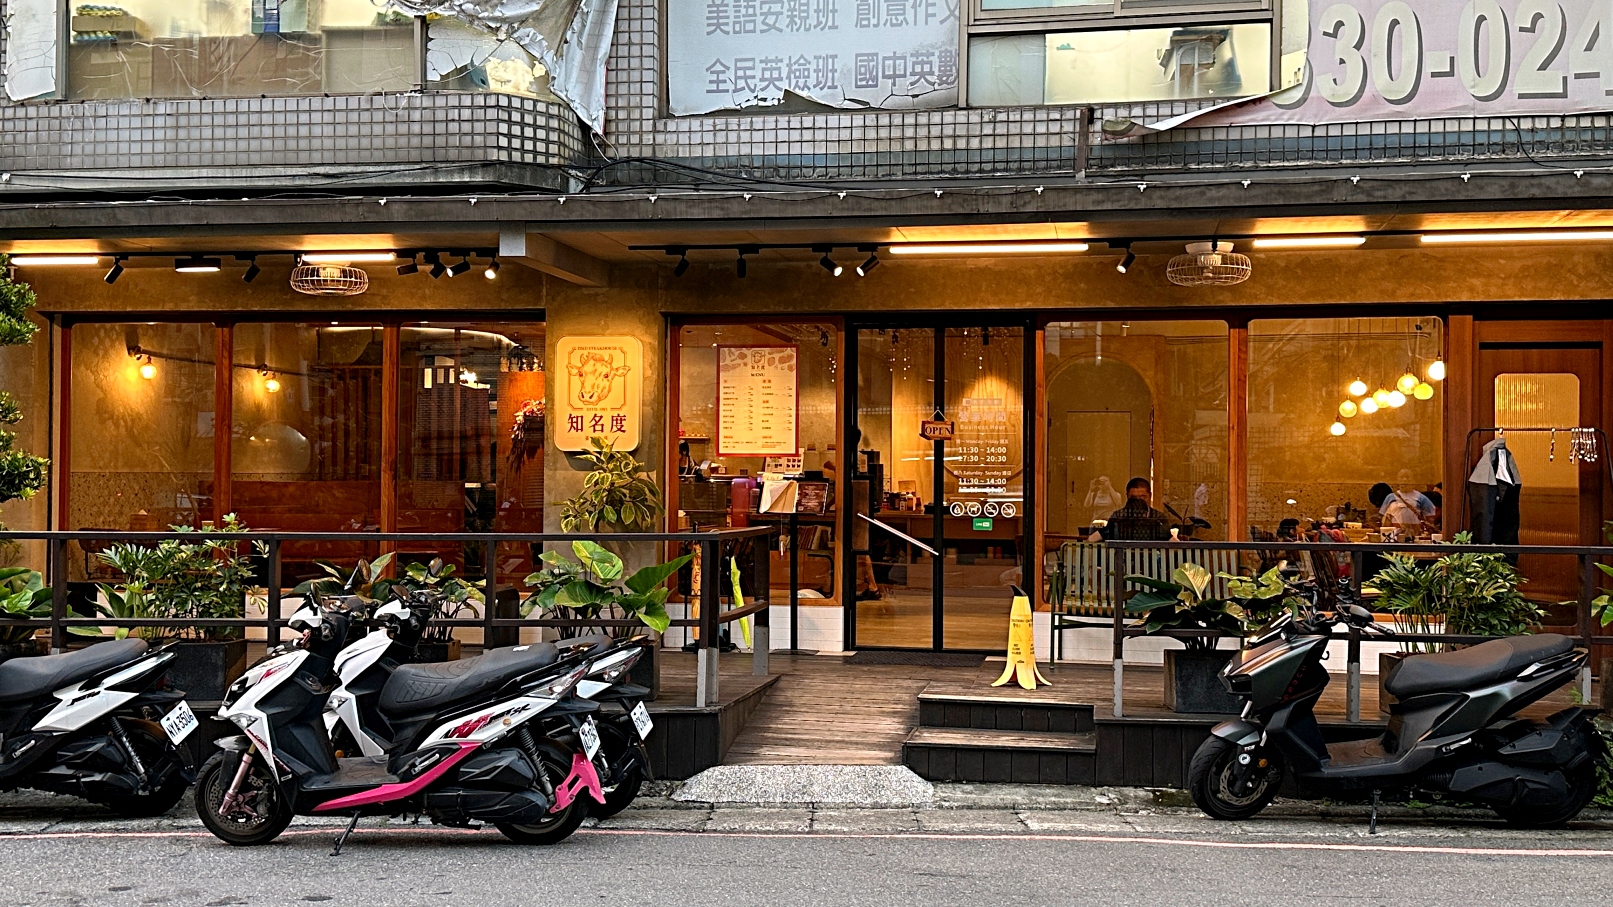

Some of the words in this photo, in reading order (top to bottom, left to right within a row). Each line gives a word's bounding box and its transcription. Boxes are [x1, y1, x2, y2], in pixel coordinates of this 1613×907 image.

[1271, 0, 1613, 109] 30-024
[705, 53, 839, 95] 全民英檢班
[567, 413, 627, 434] 知名度
[924, 426, 952, 435] OPEN
